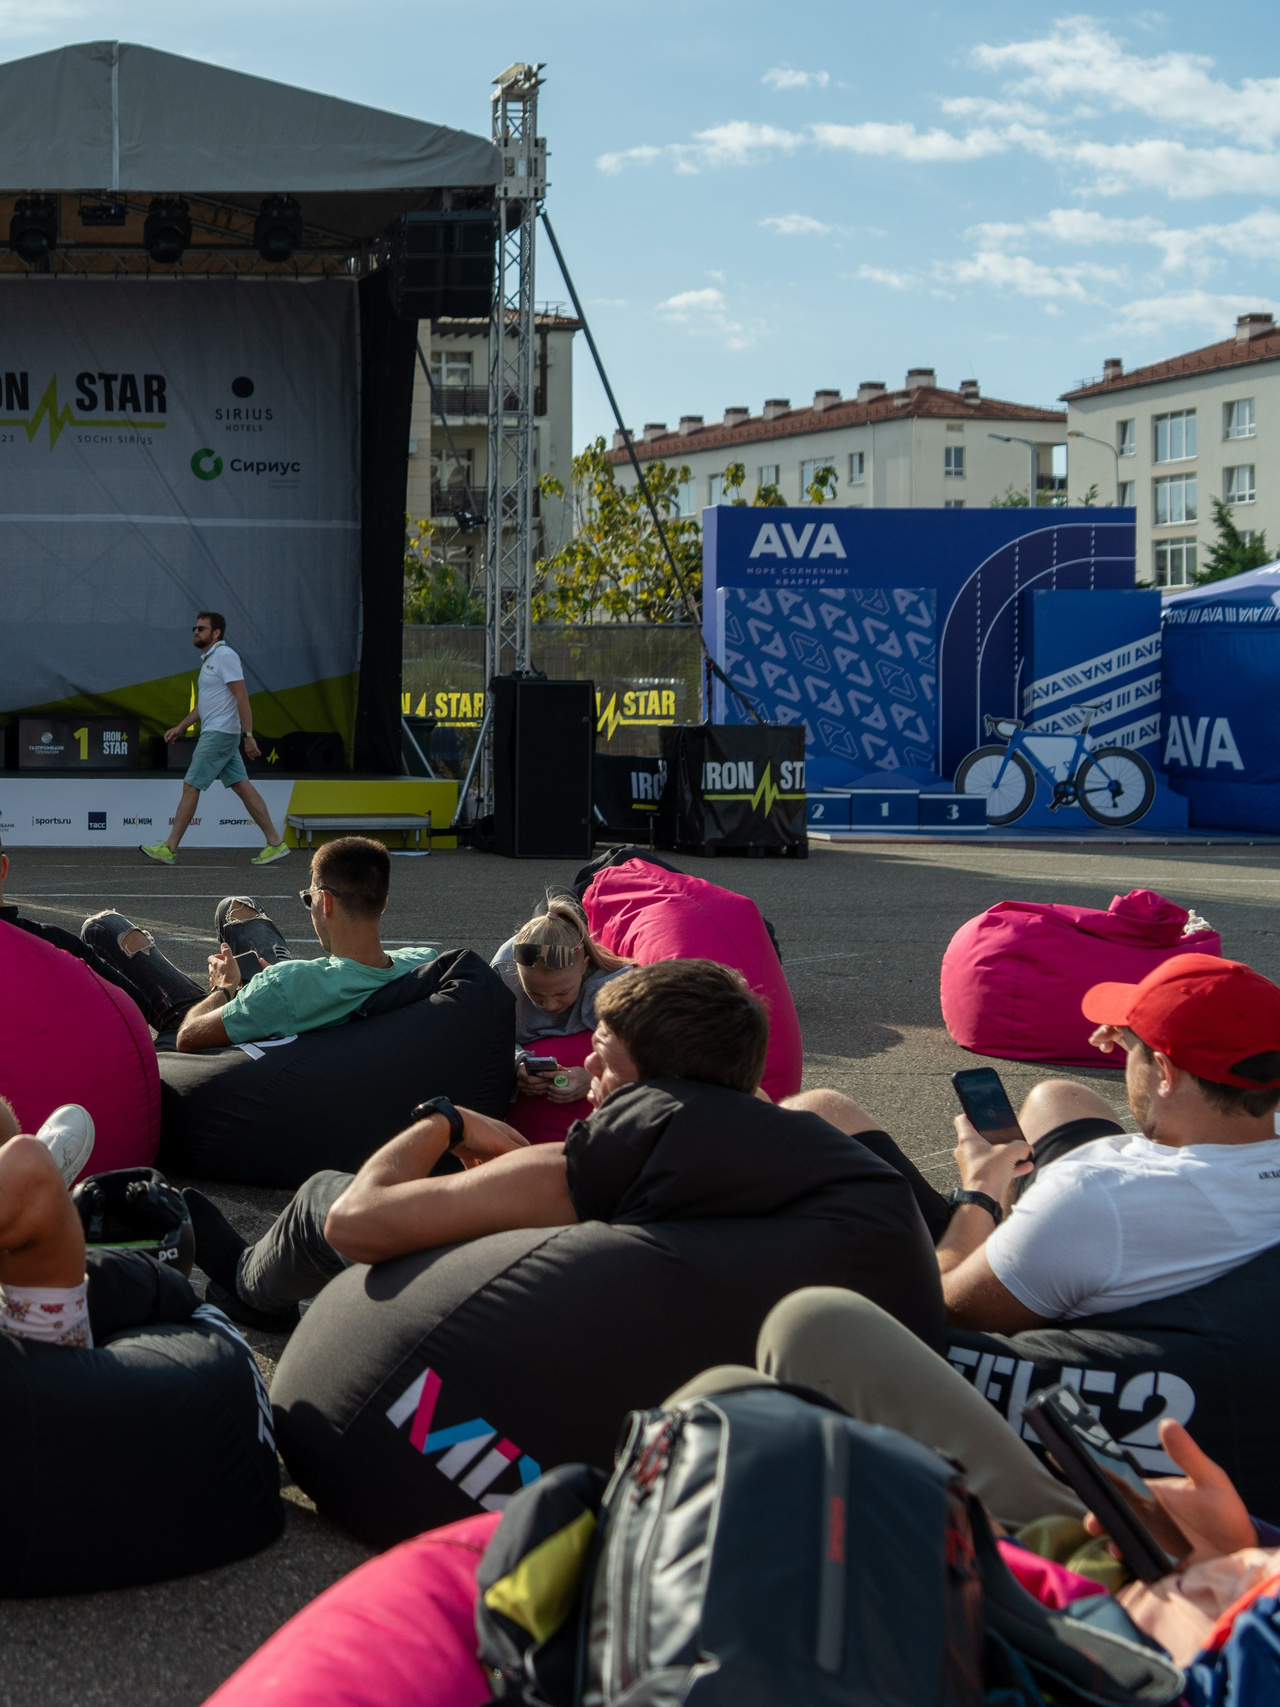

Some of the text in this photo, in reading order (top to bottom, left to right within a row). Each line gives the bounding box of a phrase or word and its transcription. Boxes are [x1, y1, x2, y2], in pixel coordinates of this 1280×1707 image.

[75, 372, 166, 413] STAR
[215, 408, 273, 420] SIRIUS
[225, 424, 263, 432] HOTELS
[77, 435, 112, 443] SOCHI
[118, 435, 153, 445] SIRIUS
[230, 458, 301, 475] Сириус
[749, 523, 847, 559] AVA
[746, 567, 850, 575] МОРЕ СОЛНЕЧНЫХ
[435, 692, 484, 718] STAR
[623, 690, 676, 716] STAR
[73, 727, 88, 760] 1
[103, 731, 121, 741] IRON
[1163, 715, 1245, 770] AVA
[103, 742, 127, 754] STAR
[631, 771, 662, 800] IRO
[701, 761, 805, 789] IRON ST
[811, 802, 960, 820] 2 1 3
